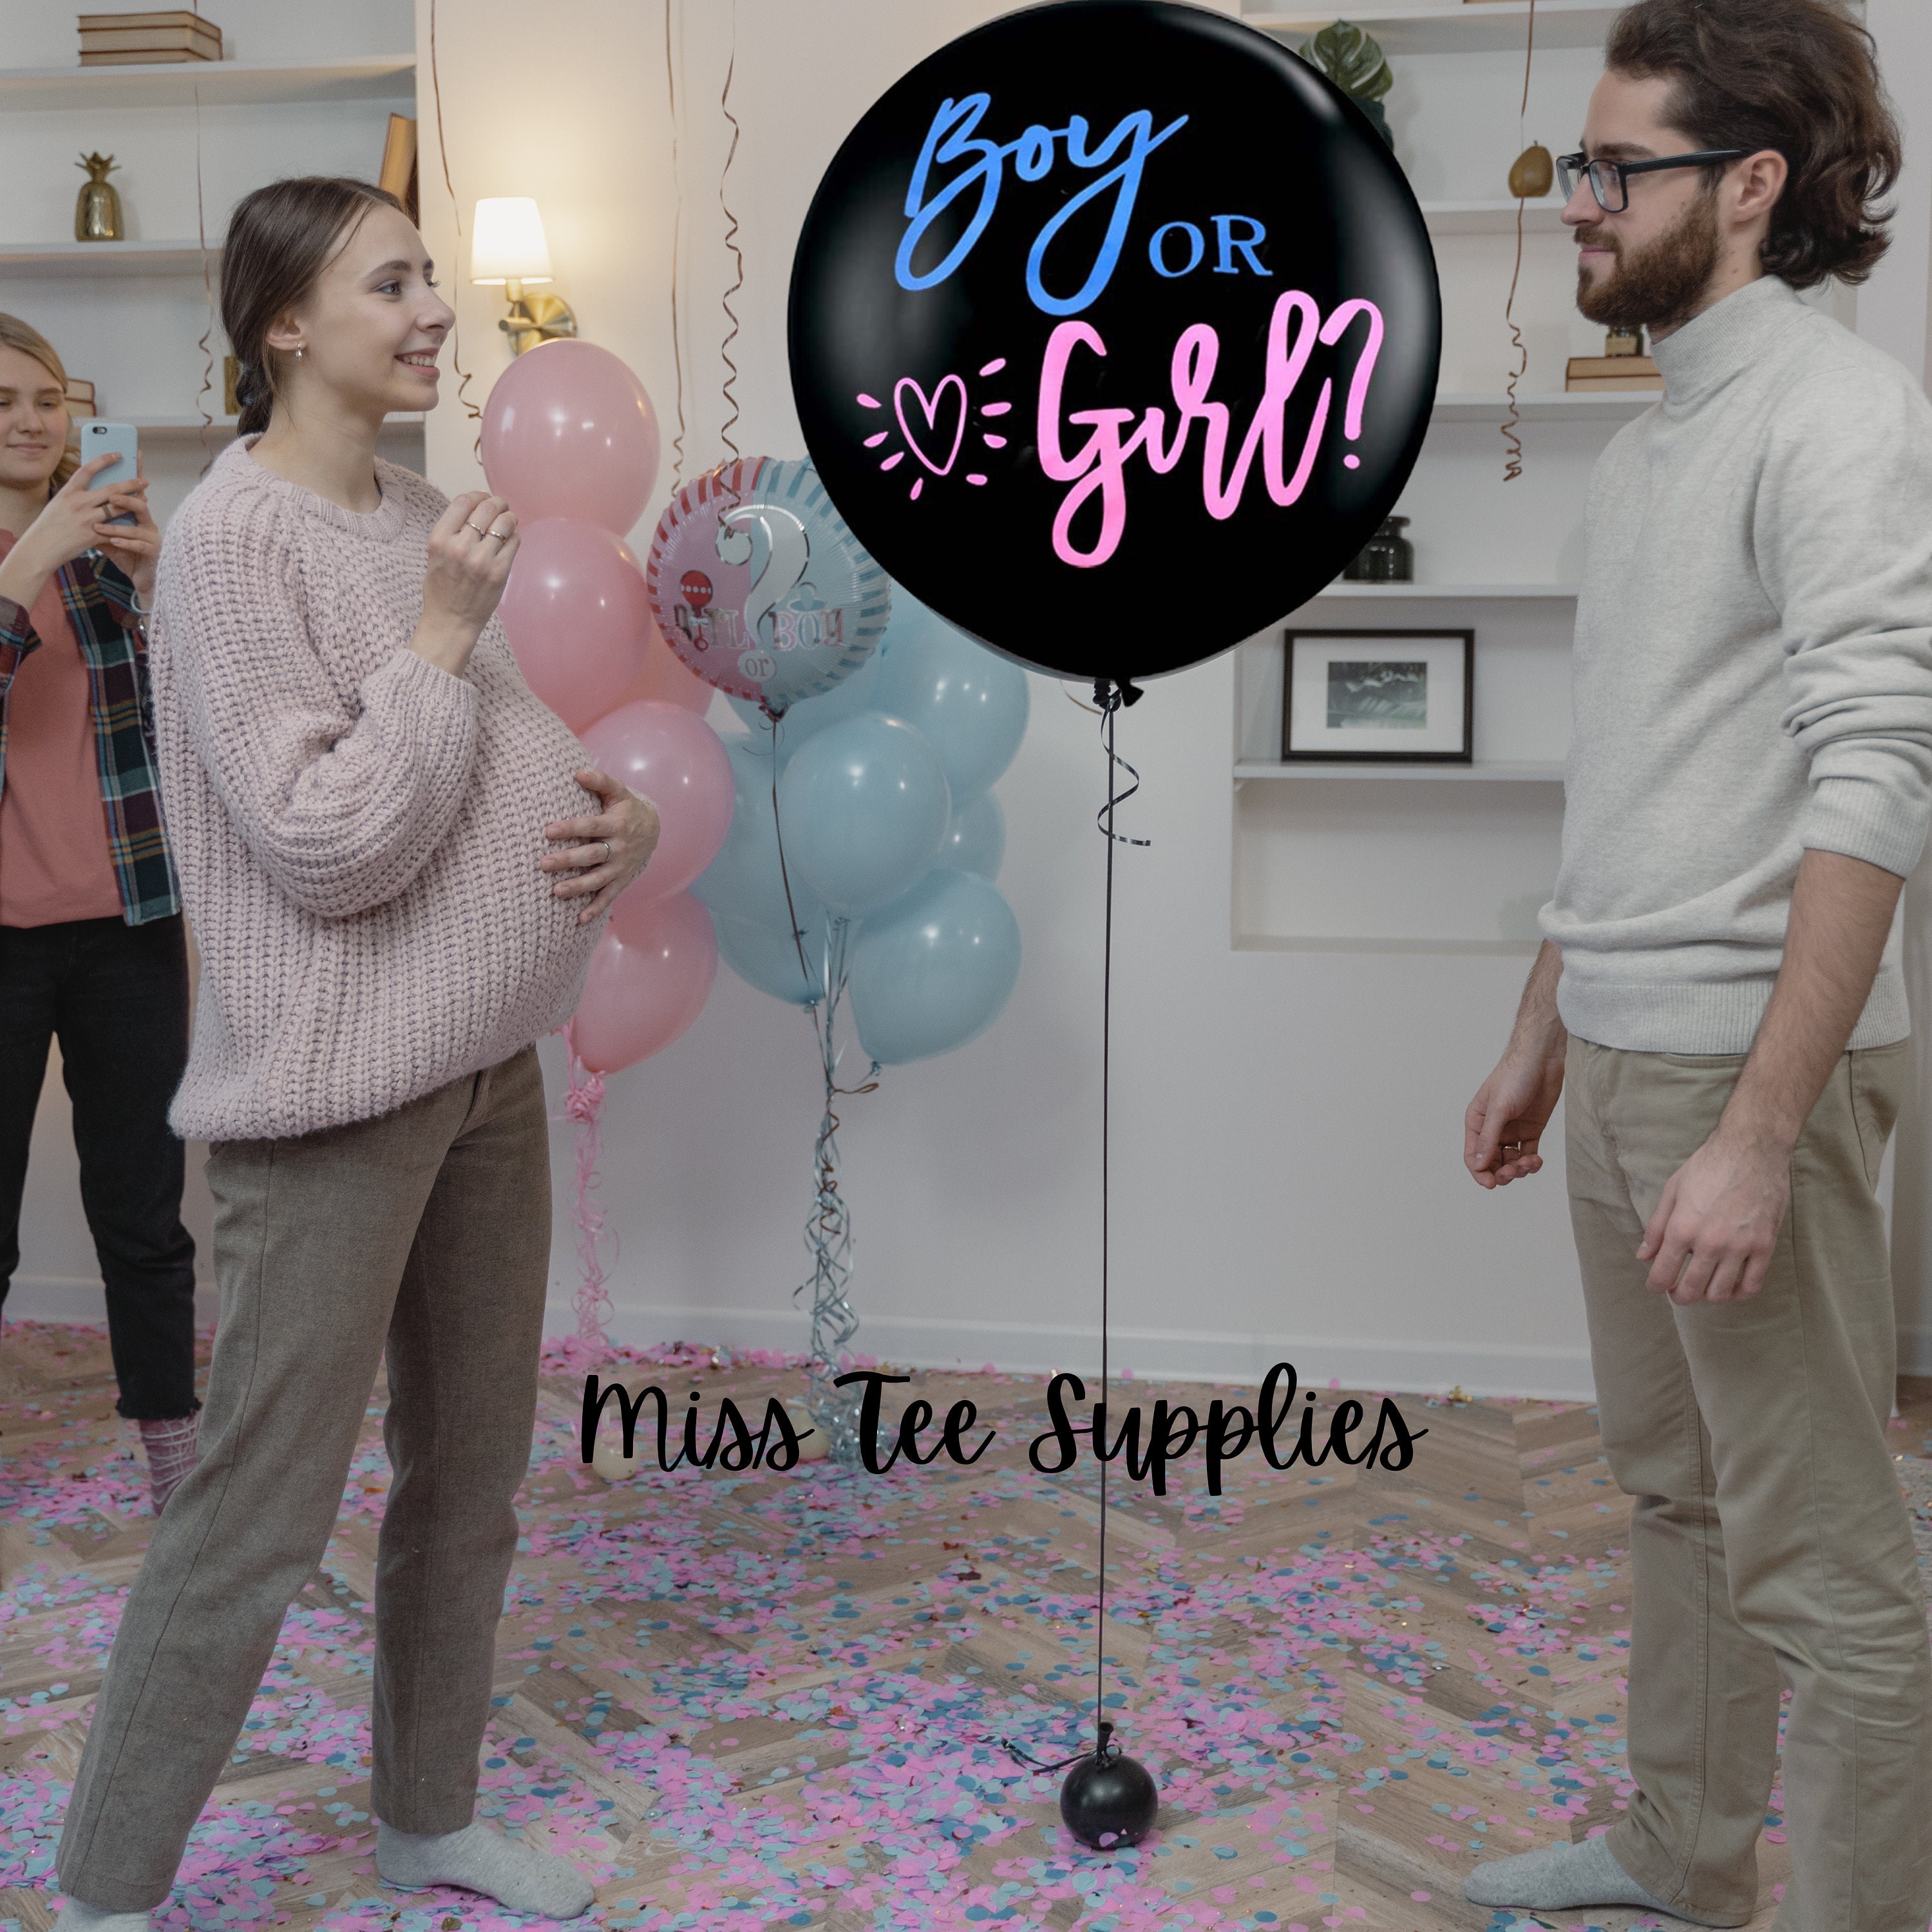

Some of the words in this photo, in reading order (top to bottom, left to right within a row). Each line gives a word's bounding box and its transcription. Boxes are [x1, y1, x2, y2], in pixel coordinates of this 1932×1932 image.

[895, 92, 1188, 316] Boy
[1149, 214, 1273, 277] OR
[1037, 290, 1385, 568] Girl?
[745, 658, 770, 677] or
